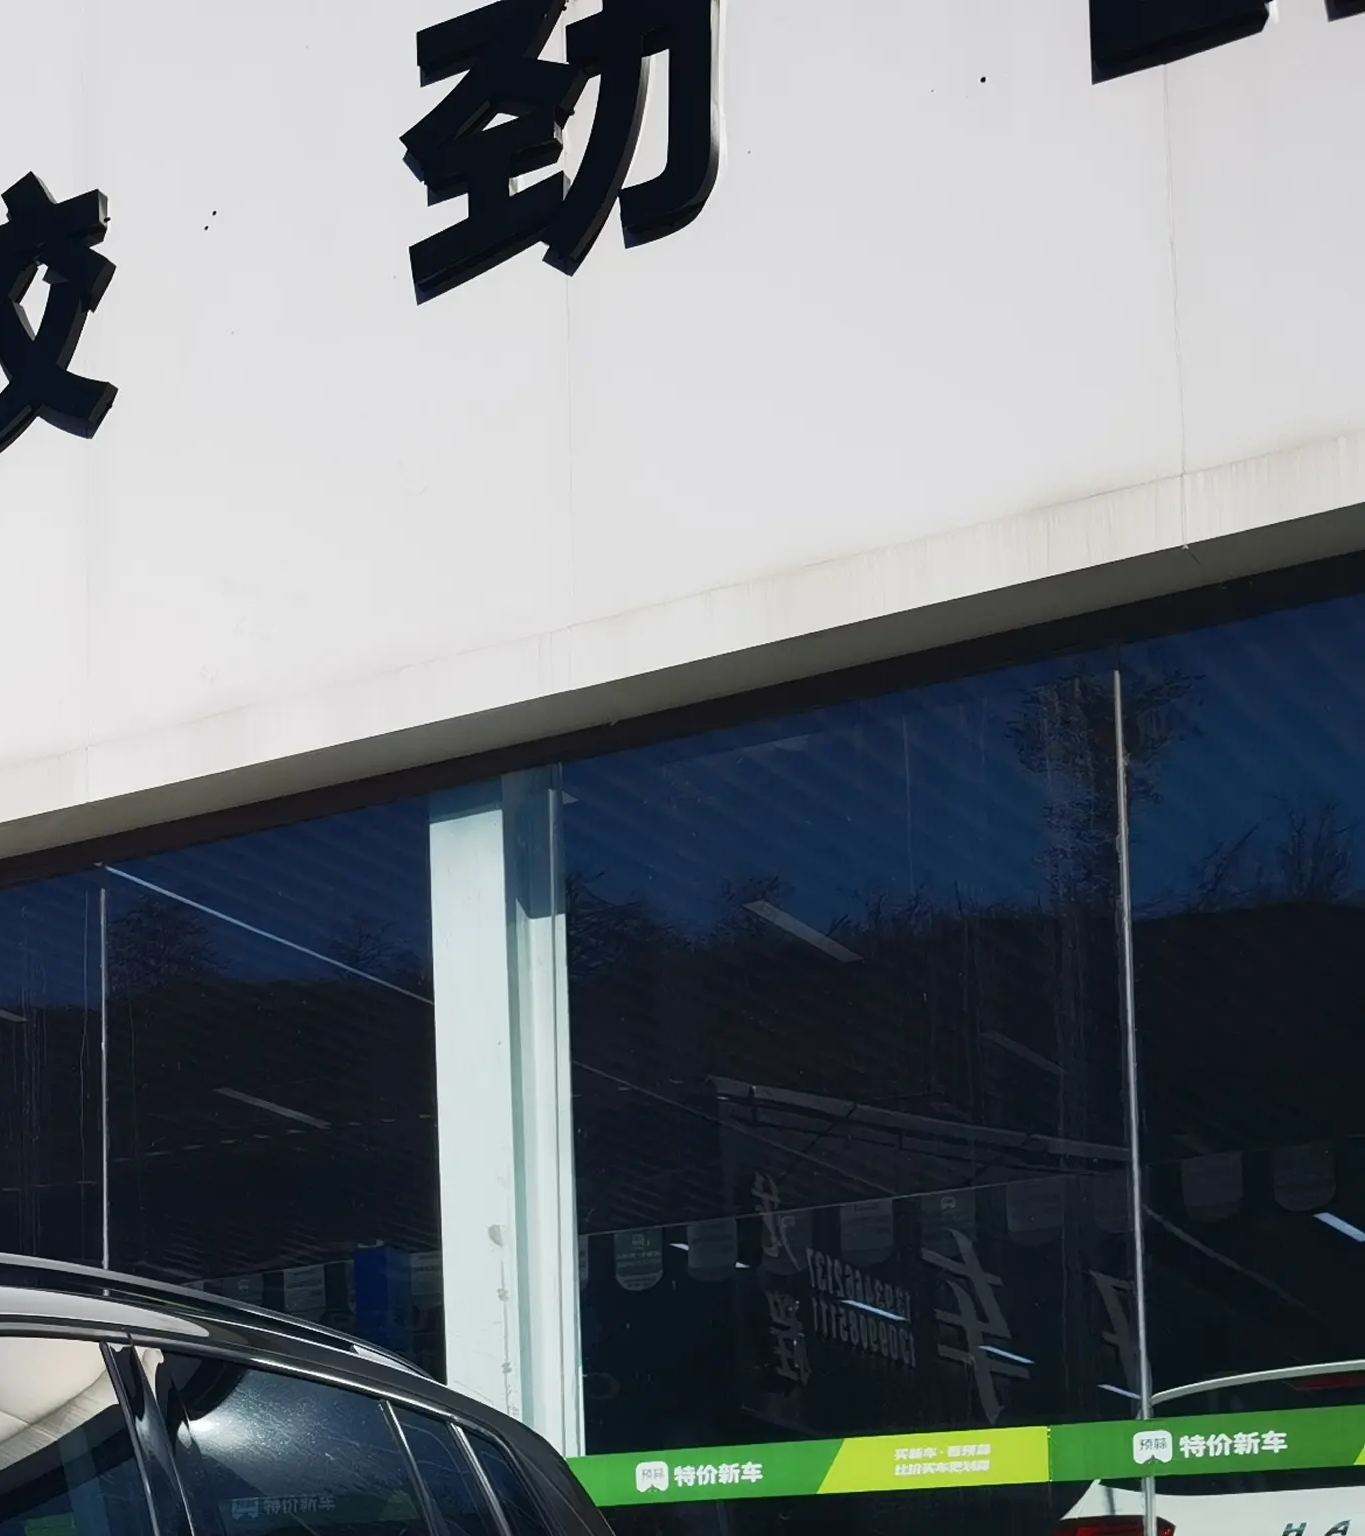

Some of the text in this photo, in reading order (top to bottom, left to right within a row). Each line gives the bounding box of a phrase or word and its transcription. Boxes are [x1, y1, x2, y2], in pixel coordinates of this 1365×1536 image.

[1179, 1430, 1288, 1459] 特价新车
[674, 1461, 764, 1488] 特价新车
